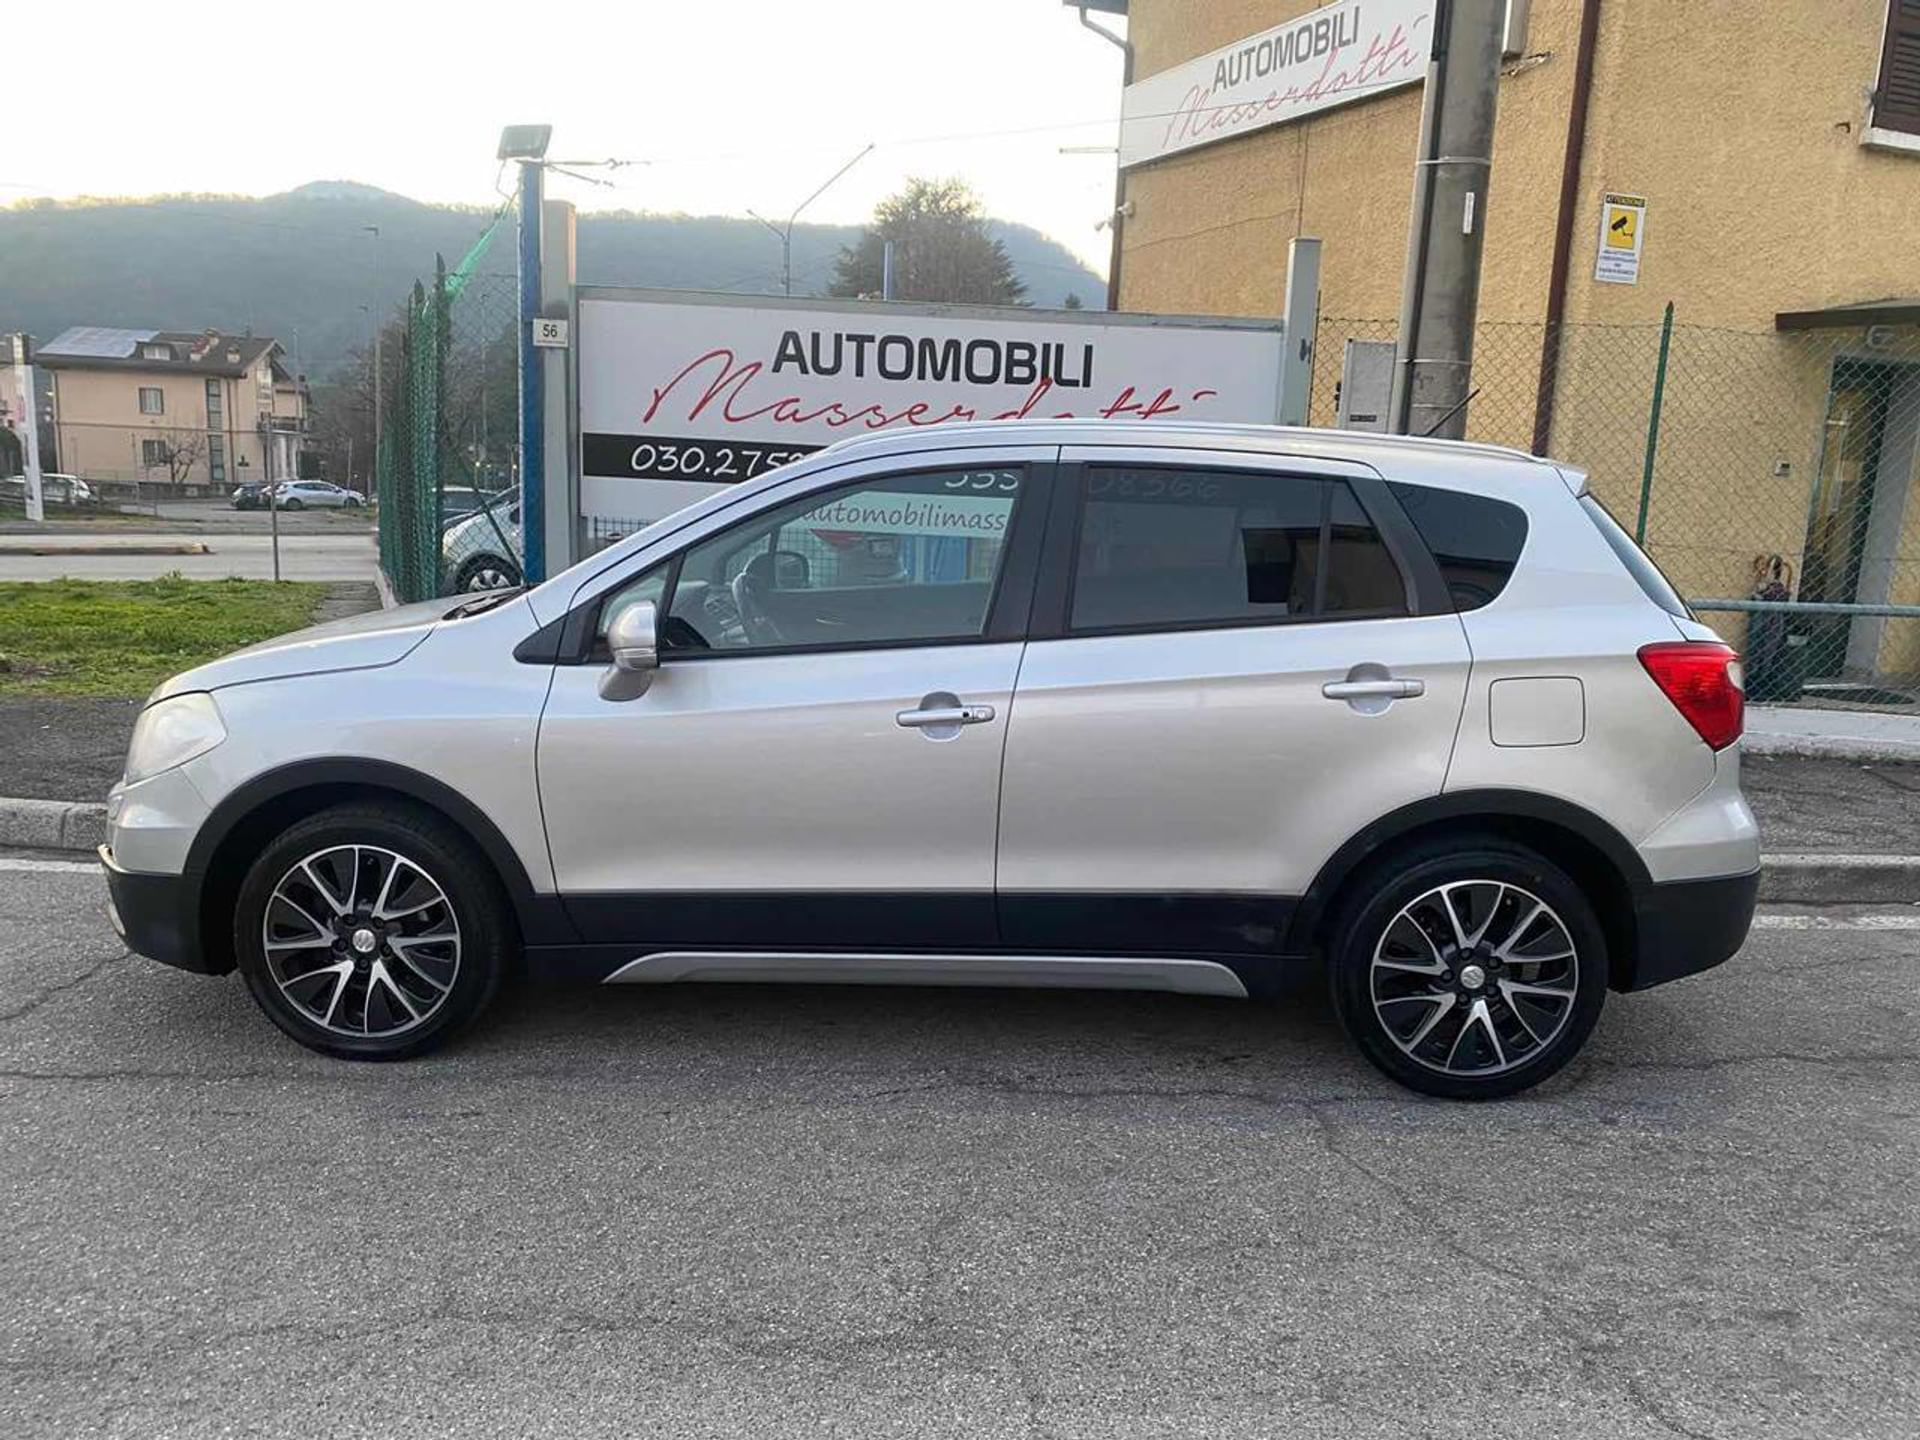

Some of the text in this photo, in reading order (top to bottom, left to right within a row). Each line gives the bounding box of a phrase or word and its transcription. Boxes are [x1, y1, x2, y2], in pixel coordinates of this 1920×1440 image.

[1162, 13, 1429, 149] Masserdotti
[1211, 6, 1361, 95] AUTOMOBILI
[542, 323, 558, 338] 56
[771, 330, 1093, 388] AUTOMOBILI
